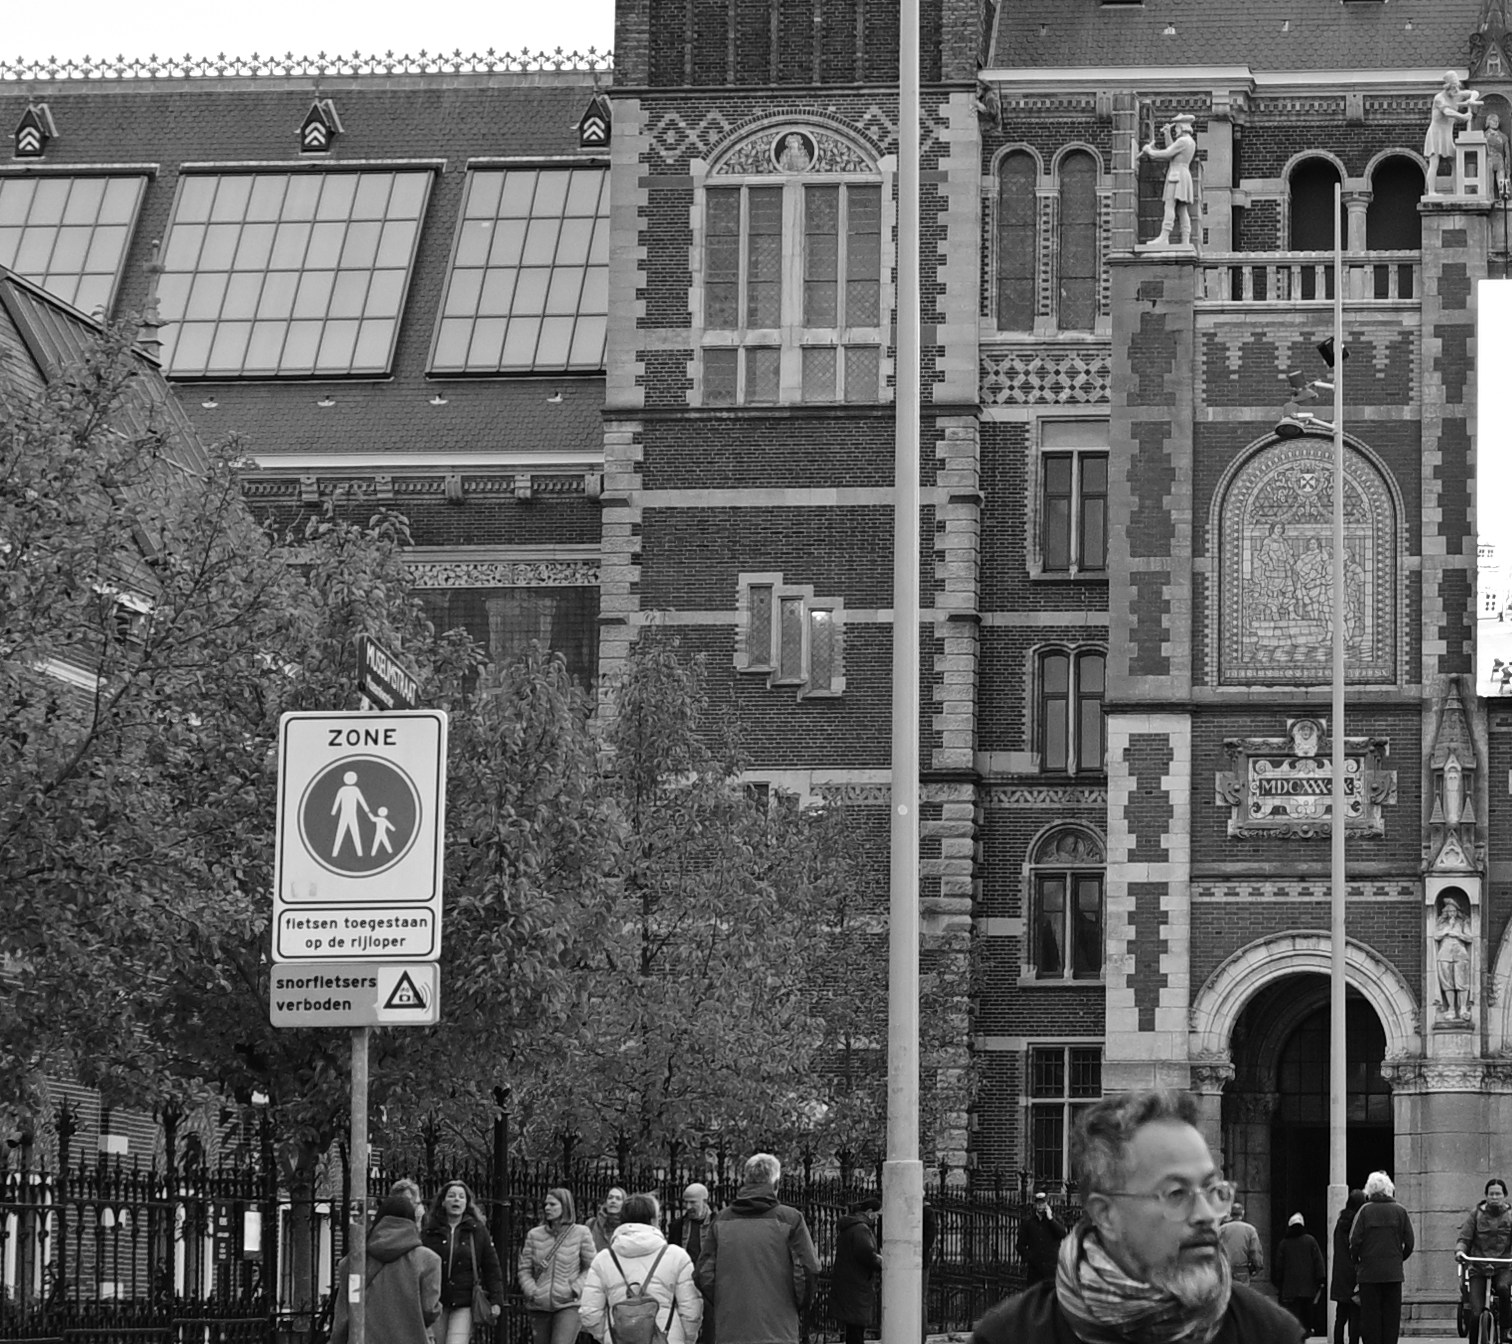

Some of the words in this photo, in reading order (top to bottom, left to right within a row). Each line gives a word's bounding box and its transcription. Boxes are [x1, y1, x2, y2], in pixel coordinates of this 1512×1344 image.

[328, 728, 397, 747] ZONE
[285, 917, 338, 930] fietsen
[343, 916, 428, 932] toegestaan
[305, 938, 323, 951] op
[327, 936, 345, 948] de
[350, 935, 407, 952] rijloper
[276, 975, 377, 990] snorfietsers
[276, 997, 352, 1012] verboden
